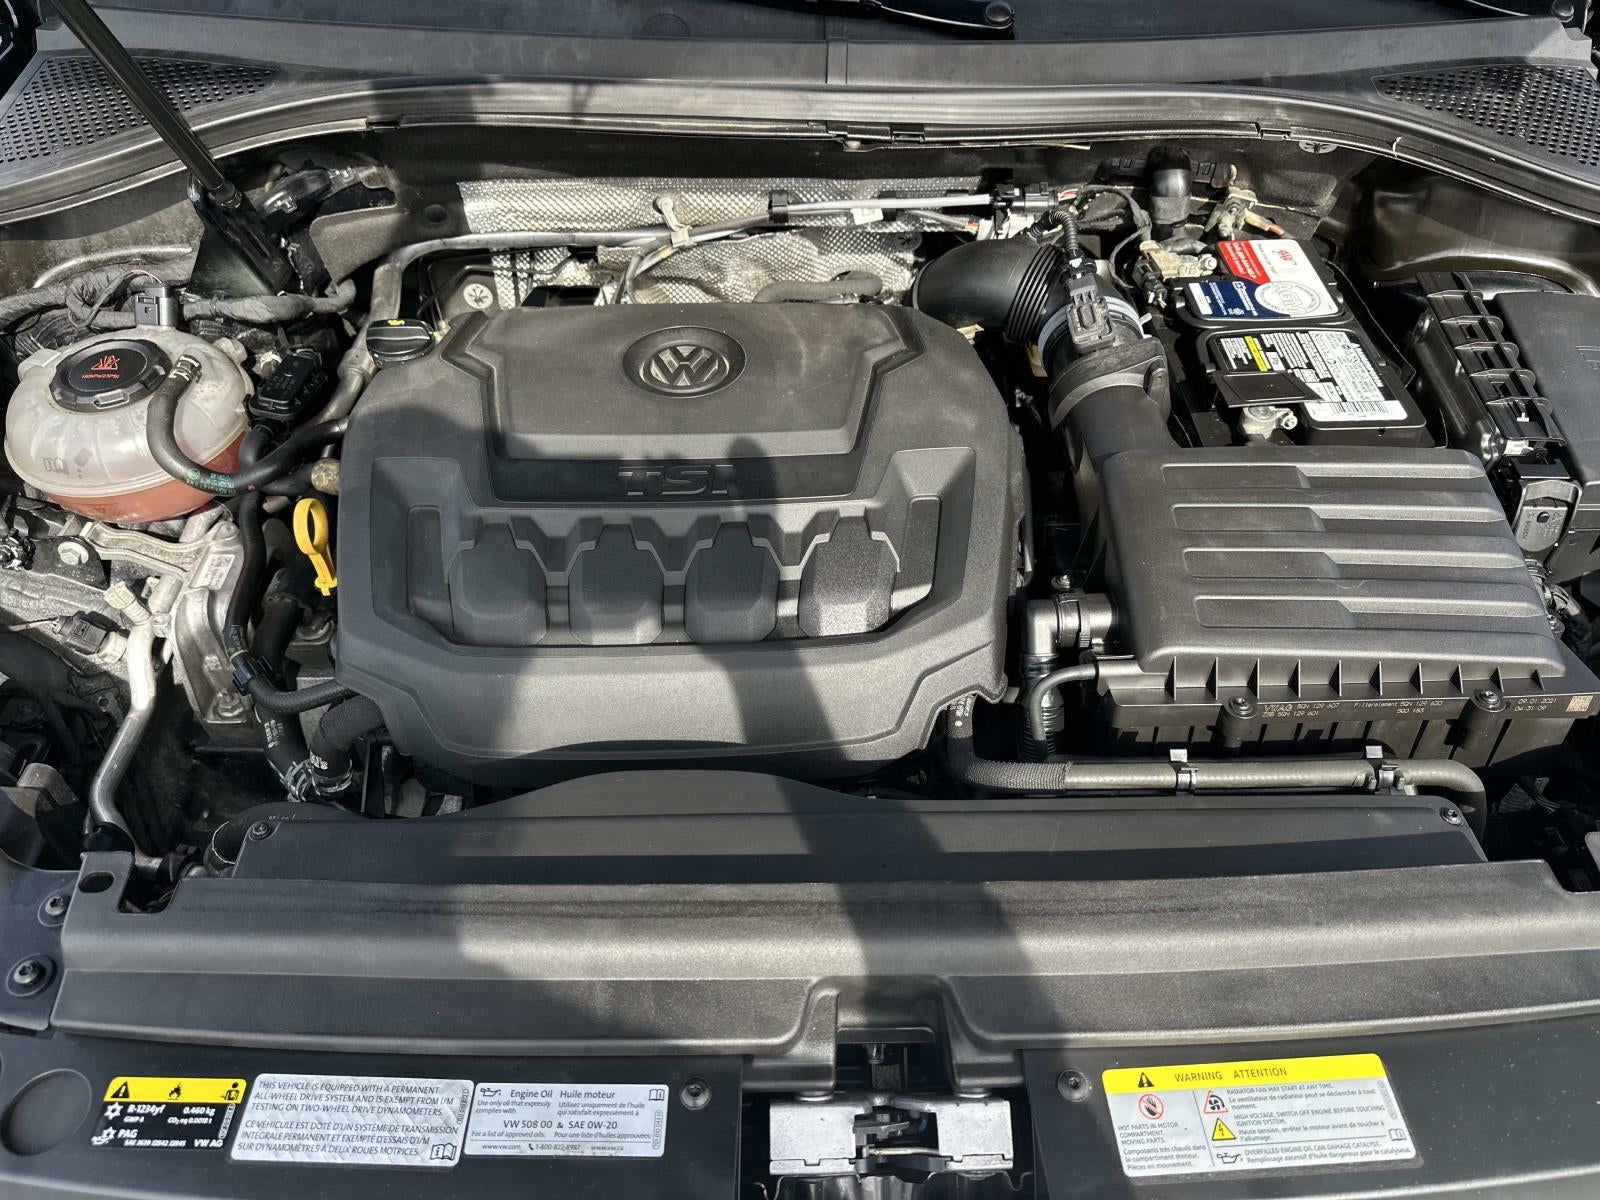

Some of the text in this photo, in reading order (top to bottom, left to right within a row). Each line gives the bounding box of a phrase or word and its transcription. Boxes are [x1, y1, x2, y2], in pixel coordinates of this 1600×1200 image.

[618, 464, 733, 495] TSI
[1174, 1067, 1286, 1081] WARNING ATTENTION
[391, 1085, 439, 1093] PERMANENT
[510, 1089, 538, 1099] Engine
[127, 1104, 165, 1115] R-1234yf
[300, 1104, 348, 1112] TWO-WHEEL
[256, 1119, 294, 1128] VÉHICULE
[310, 1120, 331, 1130] DOTÉ
[354, 1122, 387, 1132] SYSTÈME
[401, 1125, 458, 1134] TRANSMISSION
[117, 1129, 138, 1138] PAG
[241, 1129, 282, 1139] INTÉGRALE
[283, 1132, 330, 1141] PERMANENT
[341, 1132, 375, 1143] EXEMPTÉ
[376, 1135, 408, 1144] D'ESSAIS
[255, 1141, 319, 1152] DYNAMOMÈTRES
[328, 1145, 351, 1153] DEUX
[351, 1146, 378, 1154] ROUES
